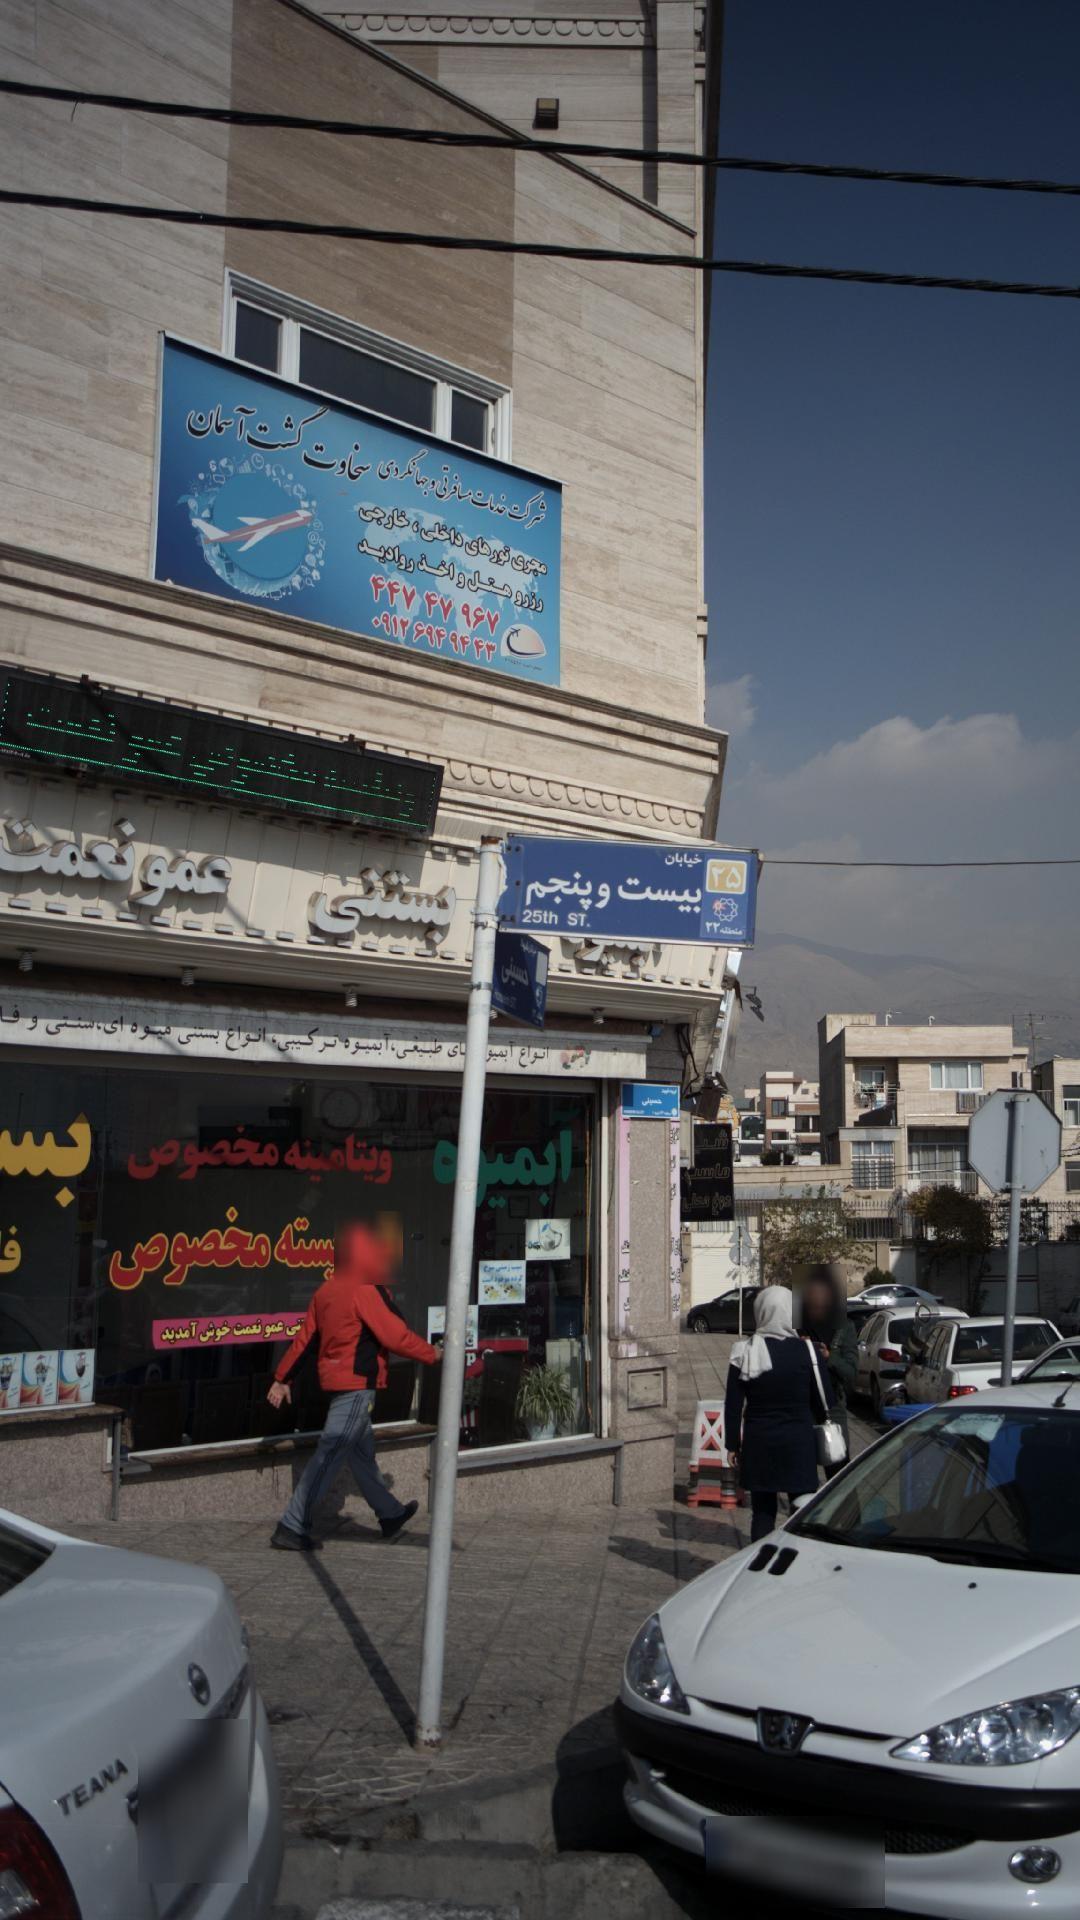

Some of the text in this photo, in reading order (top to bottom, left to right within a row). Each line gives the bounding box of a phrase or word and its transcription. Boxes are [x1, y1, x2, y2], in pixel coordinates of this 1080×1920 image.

[187, 404, 257, 441] آسمان
[246, 405, 330, 450] گشت
[302, 443, 371, 481] سخاوت
[435, 465, 473, 500] مسافرتی
[470, 492, 507, 514] خدمات
[507, 491, 546, 529] شرکت
[359, 506, 409, 530] خارجی
[358, 538, 544, 613] رزرو هتل و اخذ روادید
[511, 555, 547, 576] مجری
[370, 574, 499, 635] ۴۴۷ ۴۷ ۹۶۷
[372, 611, 410, 639] ۰۹۱۲
[665, 852, 702, 868] خیابان
[0, 818, 457, 945] بستنی عمو نعمت
[711, 865, 742, 889] ۲۵
[525, 871, 702, 914] بیست و پنجم
[522, 909, 592, 927] 25th ST.
[705, 921, 720, 933] ۲۲
[26, 1015, 38, 1031] و
[45, 1016, 95, 1035] سنتی
[131, 1022, 171, 1041] میوه
[178, 1026, 220, 1045] بستنی
[225, 1025, 266, 1051] انواع
[344, 1033, 391, 1056] آبمیوه
[447, 1041, 466, 1058] ای
[486, 1041, 514, 1062] آبمیو
[519, 1045, 549, 1068] انواع
[127, 1124, 393, 1185] ویتامینه مخصوص
[109, 1205, 271, 1291] مخصوص
[161, 1320, 198, 1344] آمدید
[199, 1321, 230, 1342] خوش
[232, 1319, 262, 1337] نعمت
[264, 1321, 284, 1338] عمو
[55, 1759, 129, 1816] TEANA
